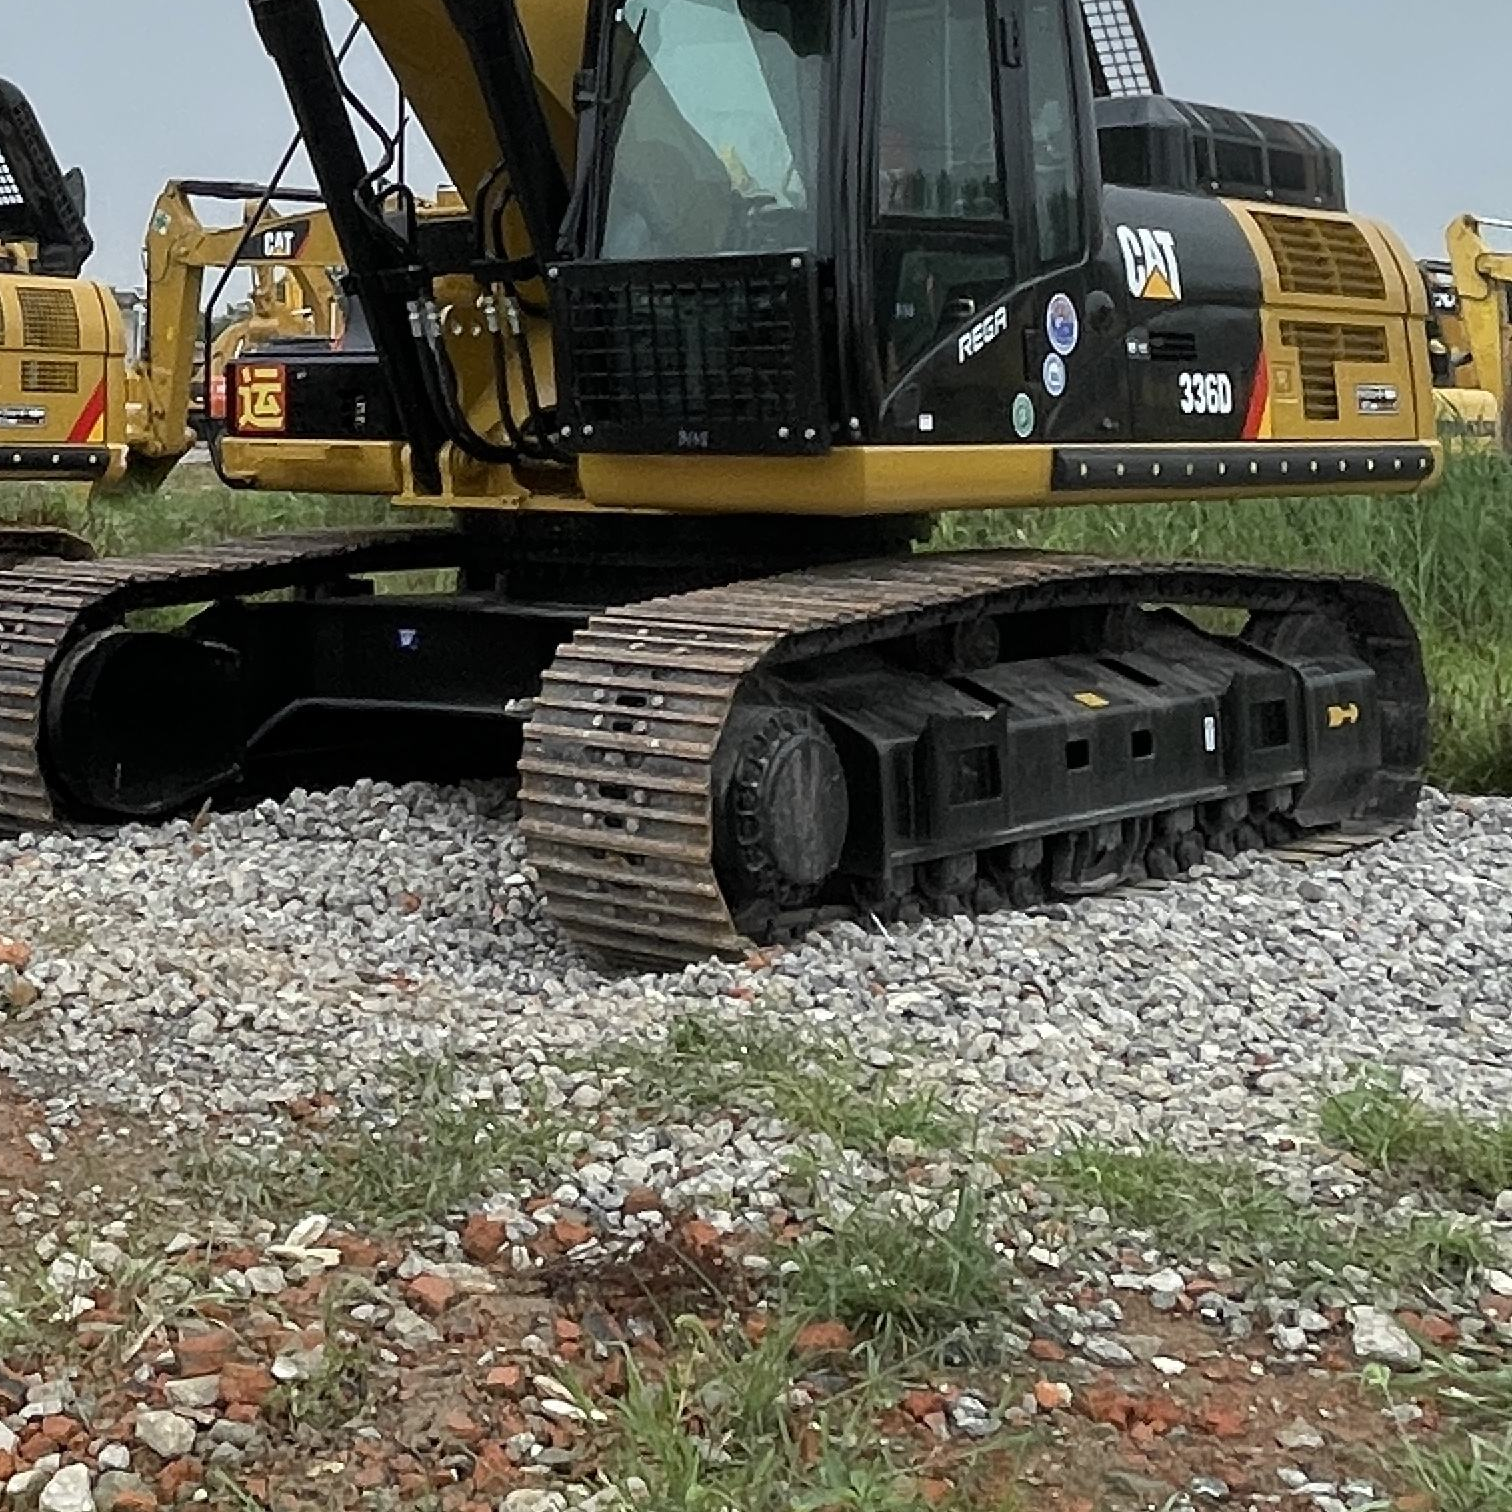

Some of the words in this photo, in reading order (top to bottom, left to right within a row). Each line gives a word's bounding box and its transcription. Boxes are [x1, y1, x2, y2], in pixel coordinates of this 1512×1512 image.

[263, 231, 295, 258] CAT
[1116, 224, 1182, 301] CAT
[238, 366, 285, 429] 运
[1178, 372, 1233, 415] 336D
